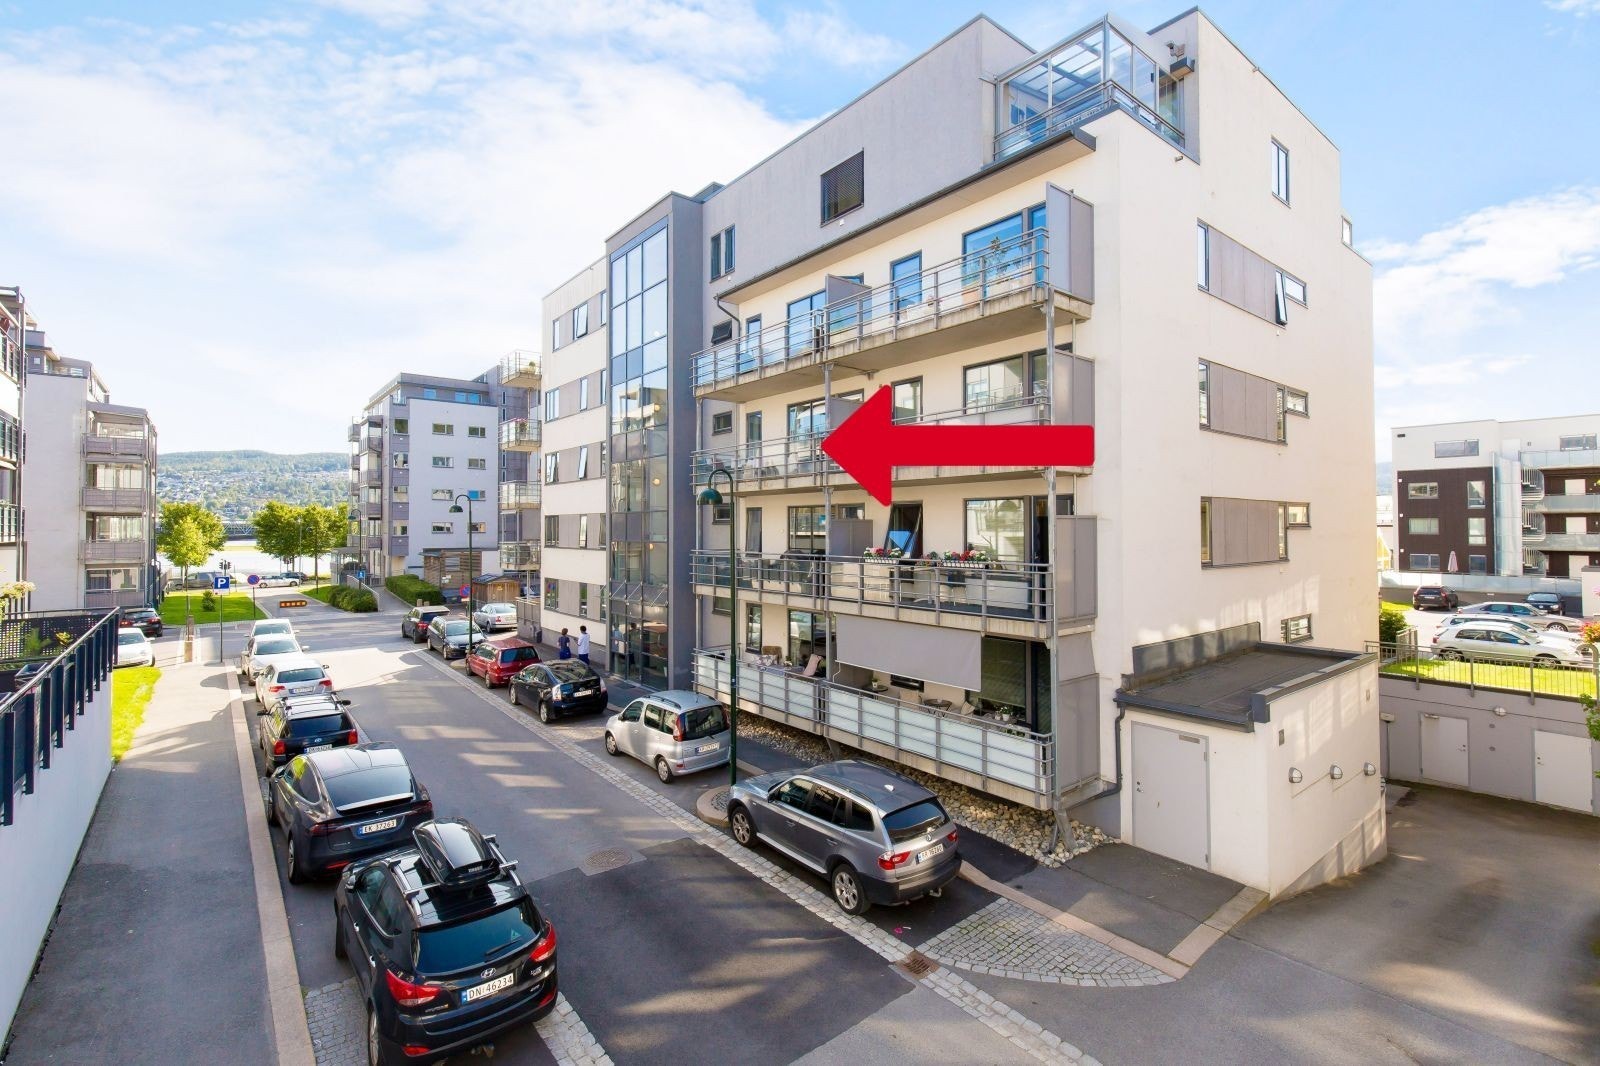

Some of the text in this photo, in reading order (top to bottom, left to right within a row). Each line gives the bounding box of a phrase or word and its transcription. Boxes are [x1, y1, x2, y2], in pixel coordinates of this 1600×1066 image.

[217, 578, 227, 588] P
[468, 986, 482, 998] DN
[486, 974, 513, 994] 46234
